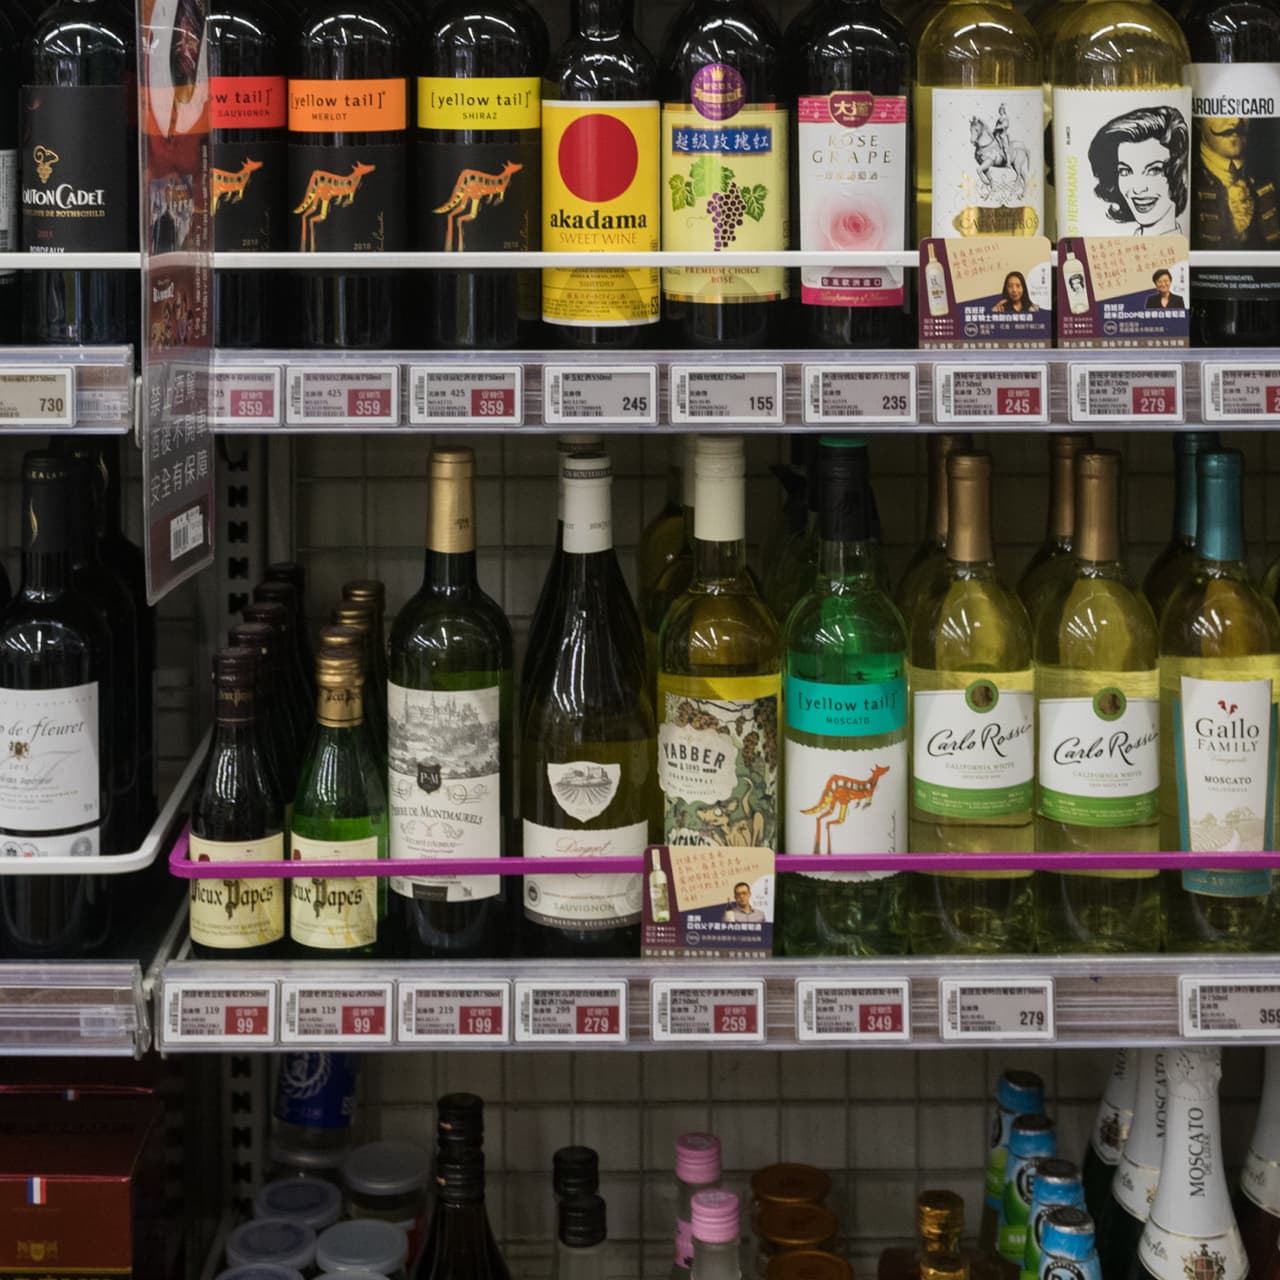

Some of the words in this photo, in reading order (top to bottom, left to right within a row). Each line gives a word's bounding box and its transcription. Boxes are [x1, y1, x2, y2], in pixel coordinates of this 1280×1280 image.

[1242, 97, 1274, 115] CARO
[311, 113, 347, 121] MERLOT
[462, 112, 498, 120] SHIRAZ
[675, 131, 769, 151] 超級玫瑰紅
[828, 135, 879, 148] ROSE
[812, 150, 892, 164] GRAPE
[550, 209, 647, 230] akadama
[560, 232, 600, 245] SWEET
[603, 231, 637, 245] WINE
[356, 401, 380, 415] 359
[749, 396, 774, 411] 155
[1141, 398, 1165, 412] 279
[826, 717, 870, 726] MOSCATO
[1195, 717, 1260, 740] Gallo
[926, 730, 978, 757] Carlo
[981, 716, 1032, 759] Rossi
[1053, 737, 1104, 767] Carlo
[1109, 726, 1160, 767] Rossi
[1198, 739, 1259, 753] FAMILY
[662, 740, 726, 770] YABBER
[1204, 774, 1252, 785] MOSCATO
[314, 876, 363, 919] Papes
[467, 1018, 492, 1032] 199
[867, 1016, 892, 1031] 349
[1188, 1107, 1205, 1198] MOSCATO
